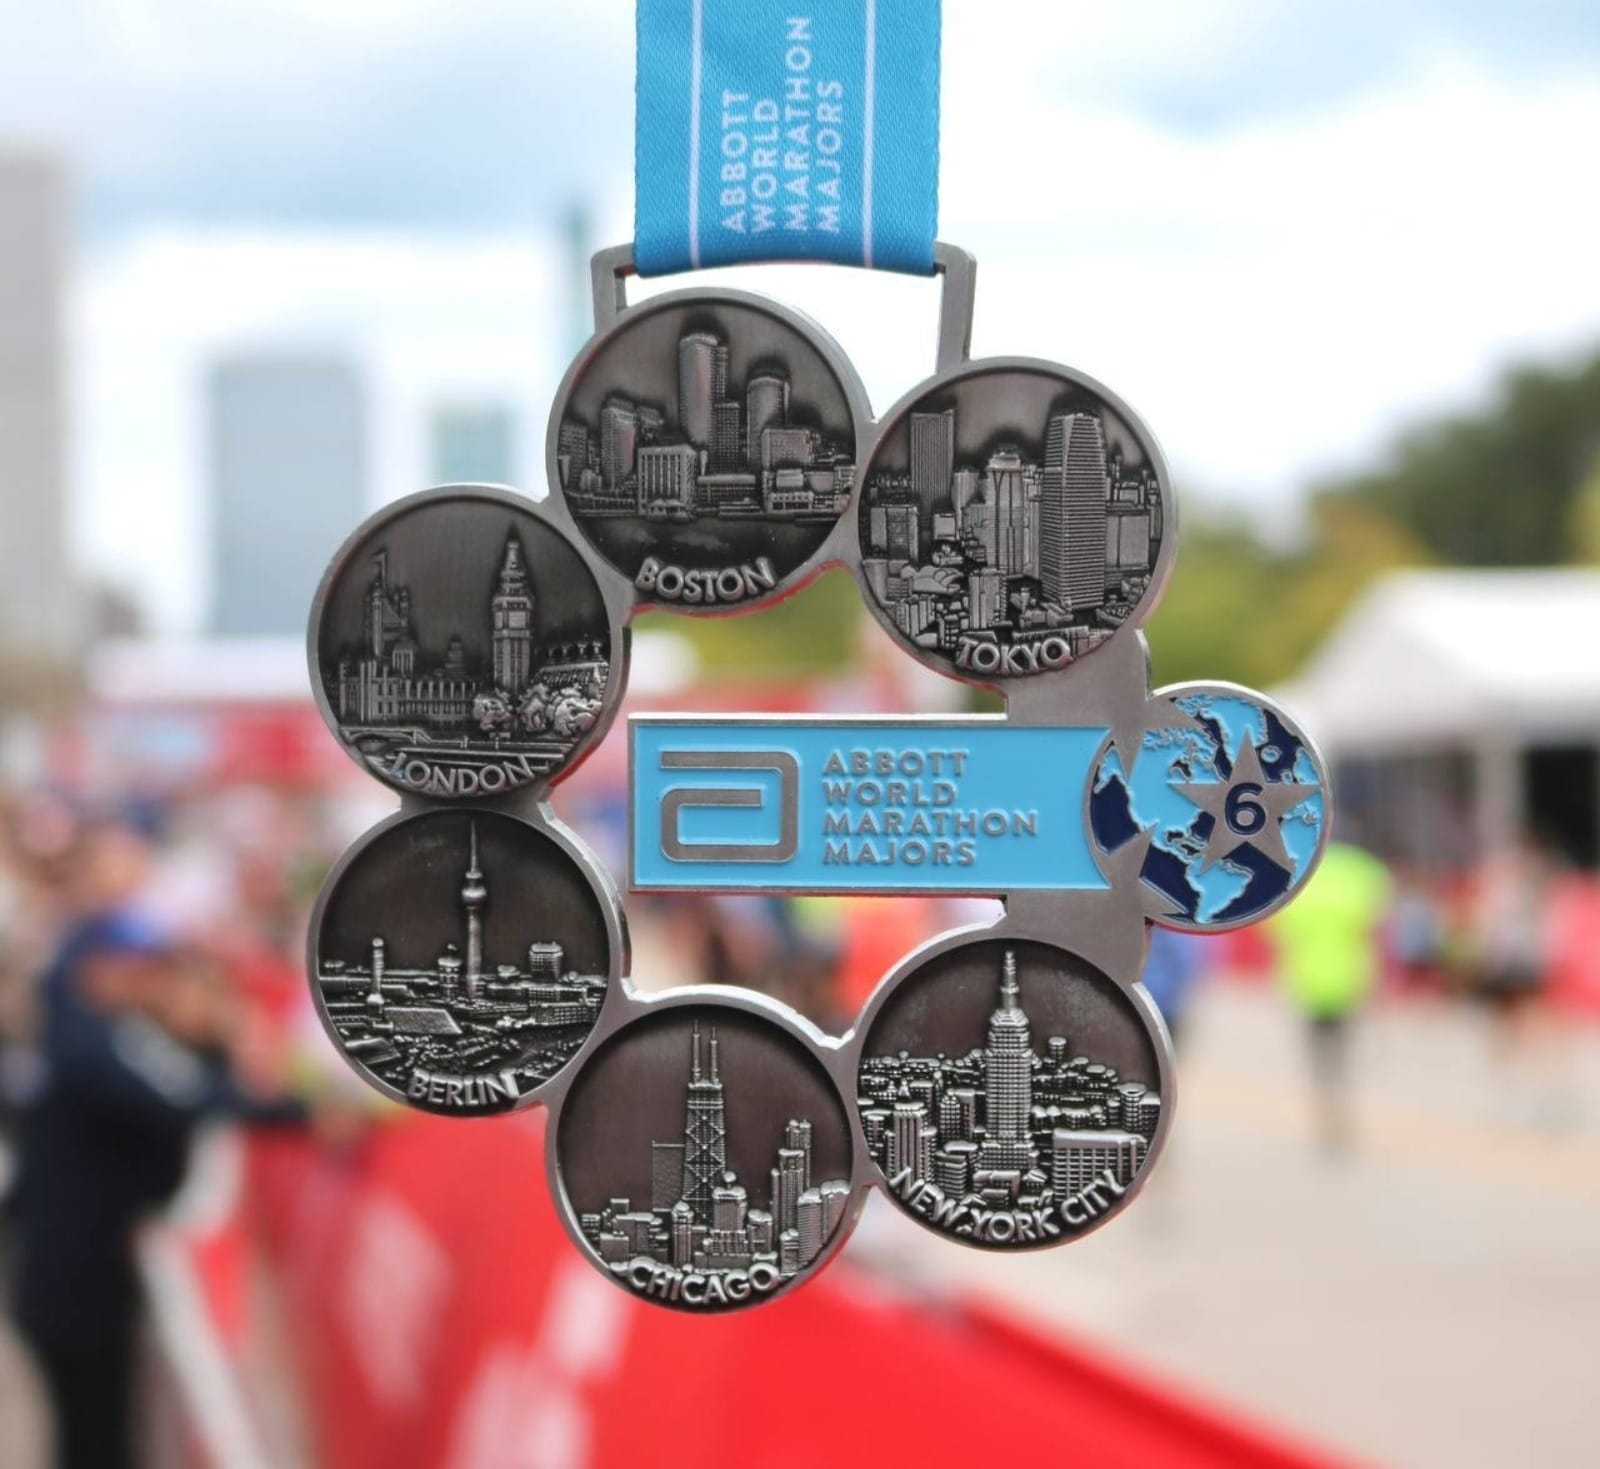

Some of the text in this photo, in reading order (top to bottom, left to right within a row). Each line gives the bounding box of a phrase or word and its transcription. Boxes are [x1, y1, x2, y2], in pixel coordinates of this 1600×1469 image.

[783, 16, 812, 233] MARATHON
[720, 88, 748, 235] ABBOTT
[751, 98, 779, 234] WORLD
[815, 80, 843, 233] MAJORS
[635, 557, 775, 601] BOSTON
[956, 636, 1071, 673] TOKYO
[386, 752, 537, 795] LONDON
[822, 748, 969, 776] ABBOTT
[822, 779, 958, 806] WORLD
[1224, 782, 1267, 836] 6
[822, 809, 1039, 837] MARATHON
[822, 838, 976, 866] MAJORS
[407, 1067, 520, 1106] BERLIN
[888, 1166, 1126, 1241] NEW YORK CITY
[628, 1256, 781, 1304] CHICAGO
